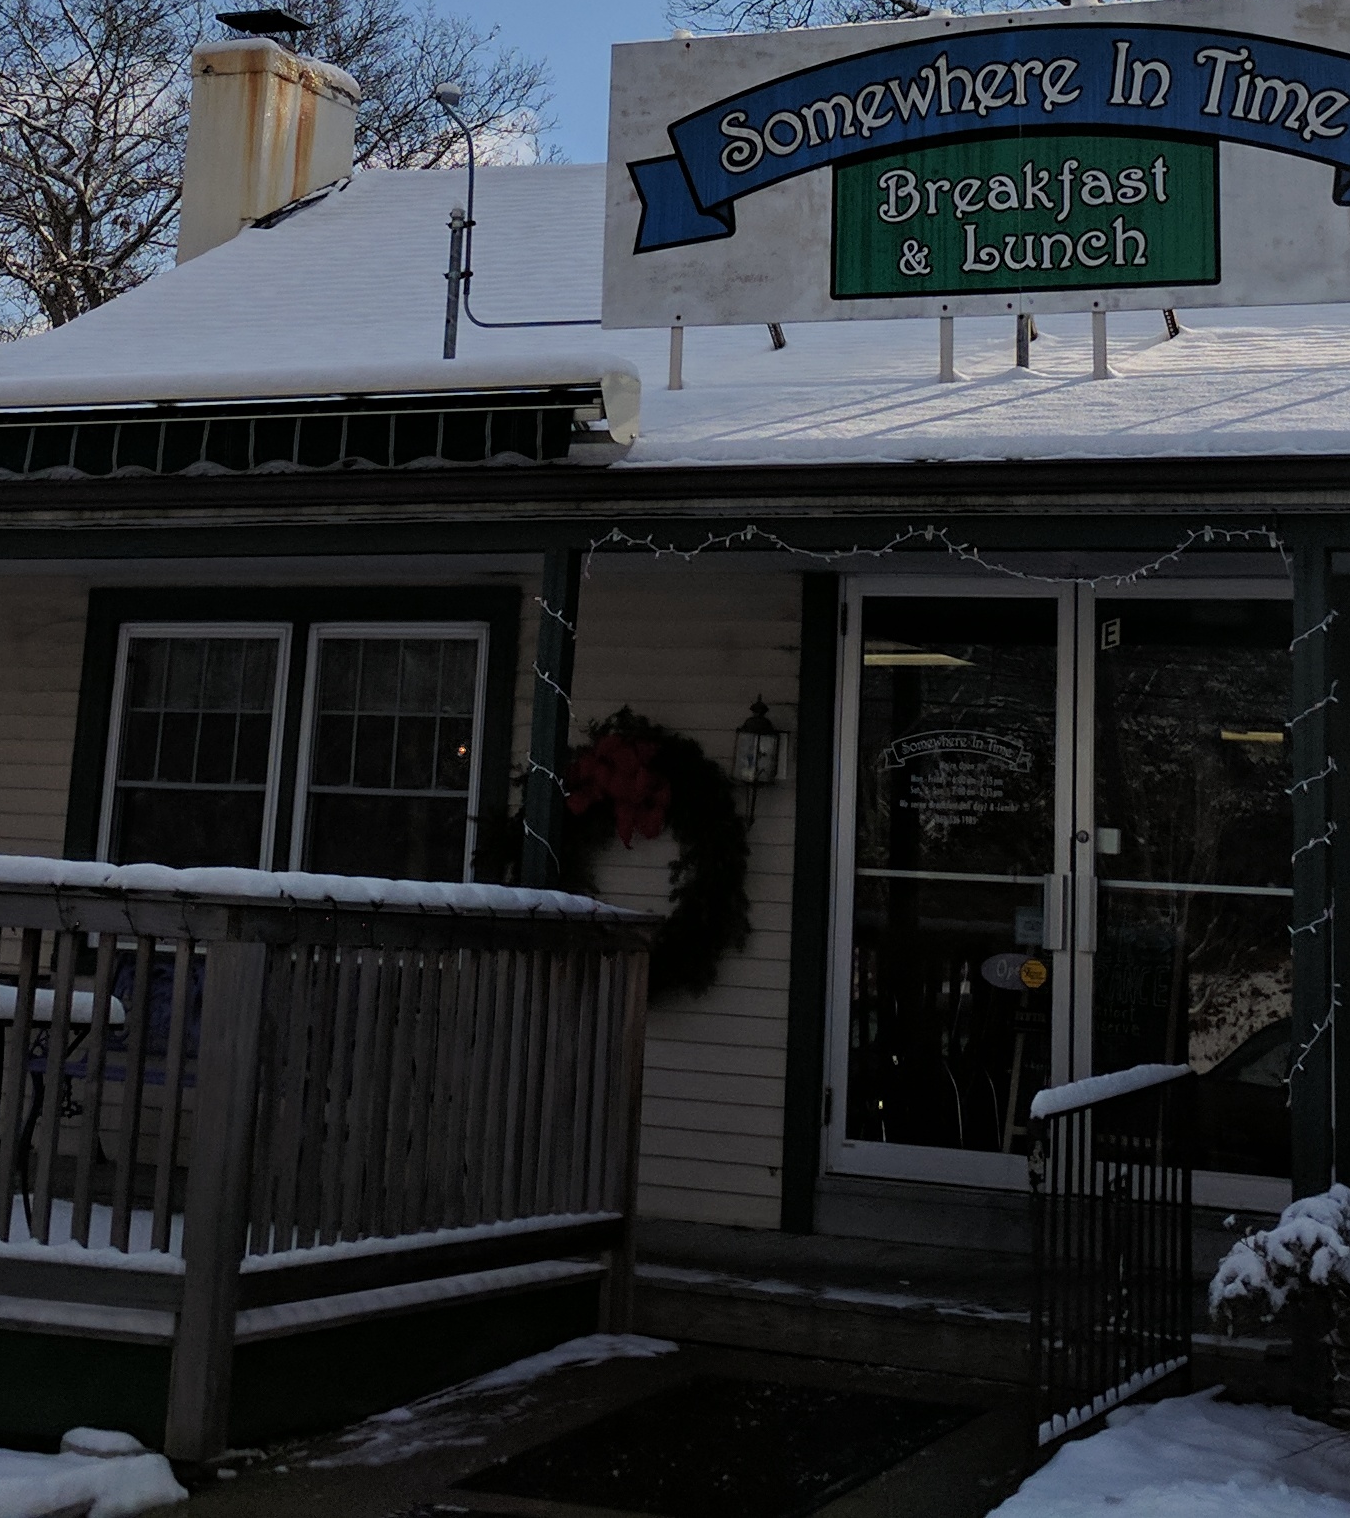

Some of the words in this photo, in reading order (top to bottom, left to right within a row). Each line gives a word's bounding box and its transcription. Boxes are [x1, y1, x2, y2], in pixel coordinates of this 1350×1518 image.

[720, 53, 1081, 173] Somewhere
[1109, 41, 1171, 108] In
[1197, 47, 1350, 141] Time
[878, 156, 1168, 223] Breakfast
[899, 239, 932, 276] &
[962, 216, 1147, 272] Lunch
[900, 734, 968, 755] Somewhere
[971, 734, 984, 749] In
[987, 737, 1015, 758] Time
